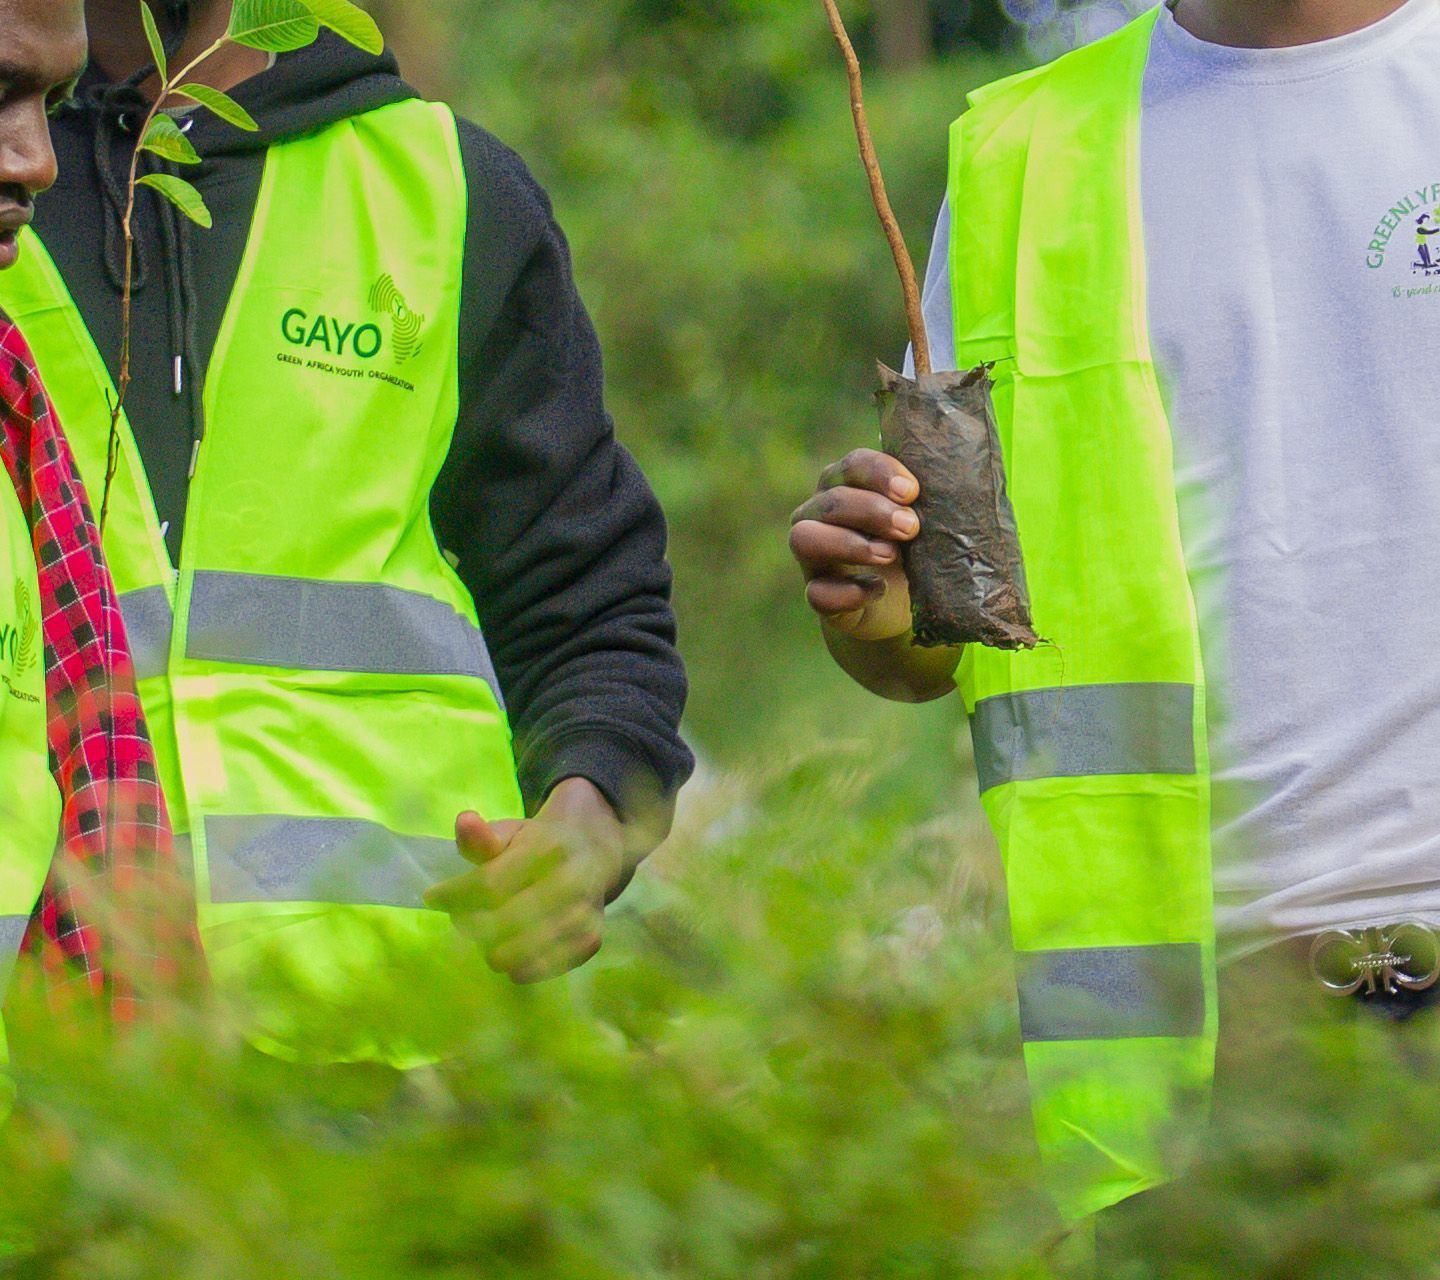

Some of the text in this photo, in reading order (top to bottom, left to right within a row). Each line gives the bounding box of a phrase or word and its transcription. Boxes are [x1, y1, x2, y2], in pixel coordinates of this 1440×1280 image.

[1366, 183, 1440, 269] GREENLYF
[281, 308, 382, 358] GAYO
[277, 353, 302, 365] GREEN
[306, 360, 334, 373] AFRICA
[335, 366, 364, 377] YOUTH
